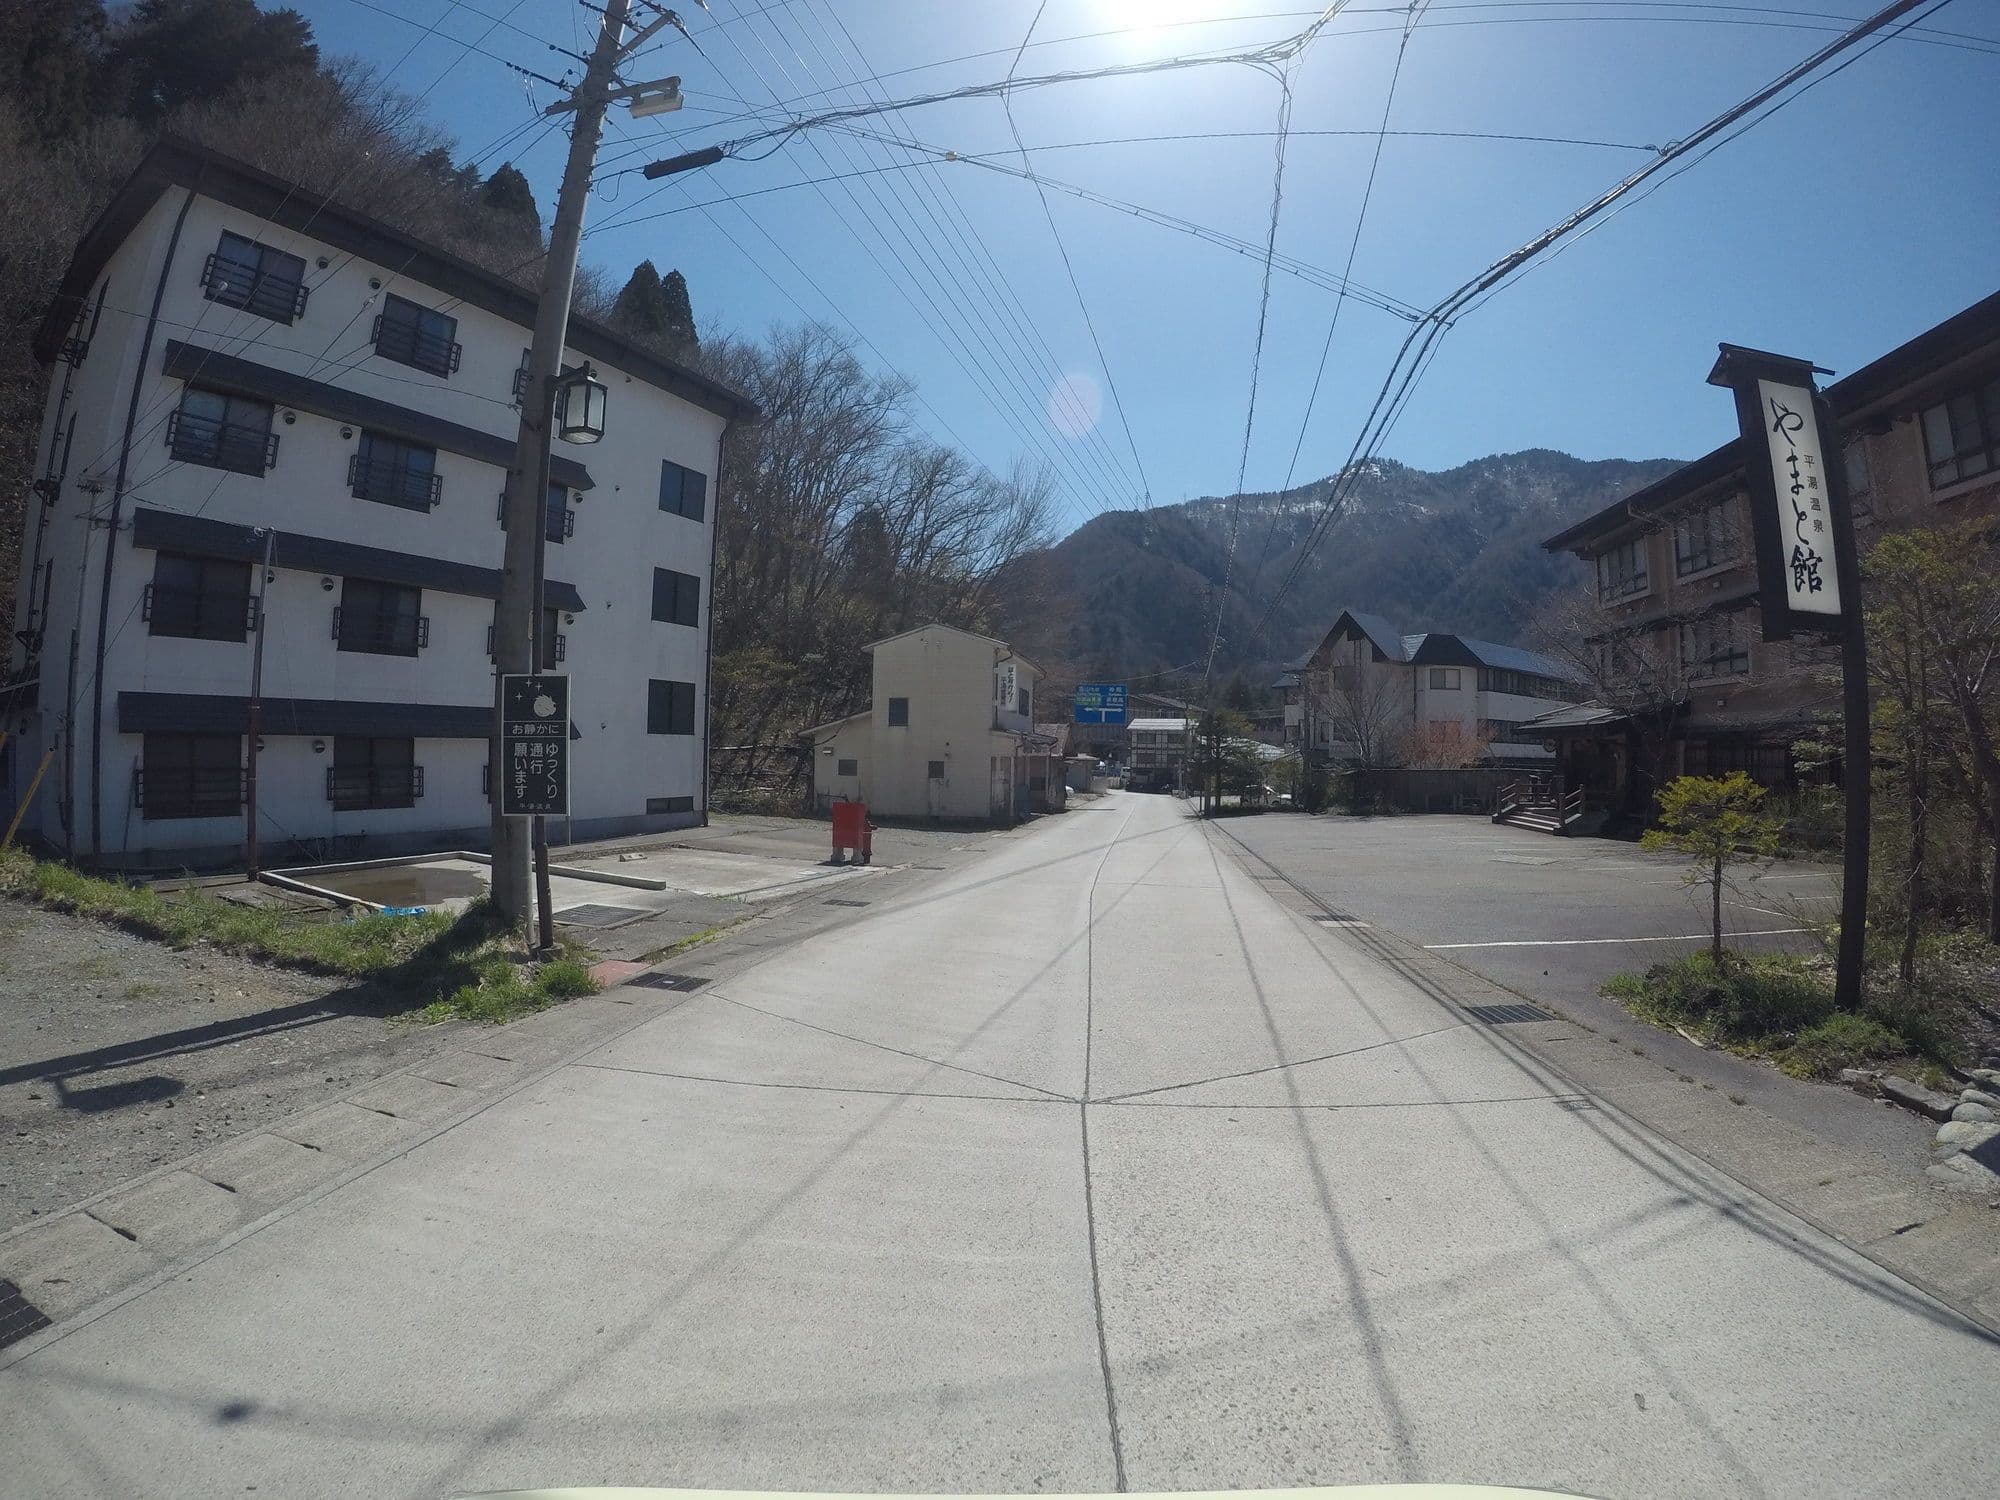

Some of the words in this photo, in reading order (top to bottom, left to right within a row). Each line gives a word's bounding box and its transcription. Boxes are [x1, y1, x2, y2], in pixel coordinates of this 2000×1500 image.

[1769, 396, 1824, 594] やまと館
[1803, 454, 1824, 533] 平湯温泉
[512, 723, 560, 735] お静かに
[514, 742, 528, 799] 願います
[529, 742, 544, 775] 通行
[545, 743, 559, 799] ゆっくり
